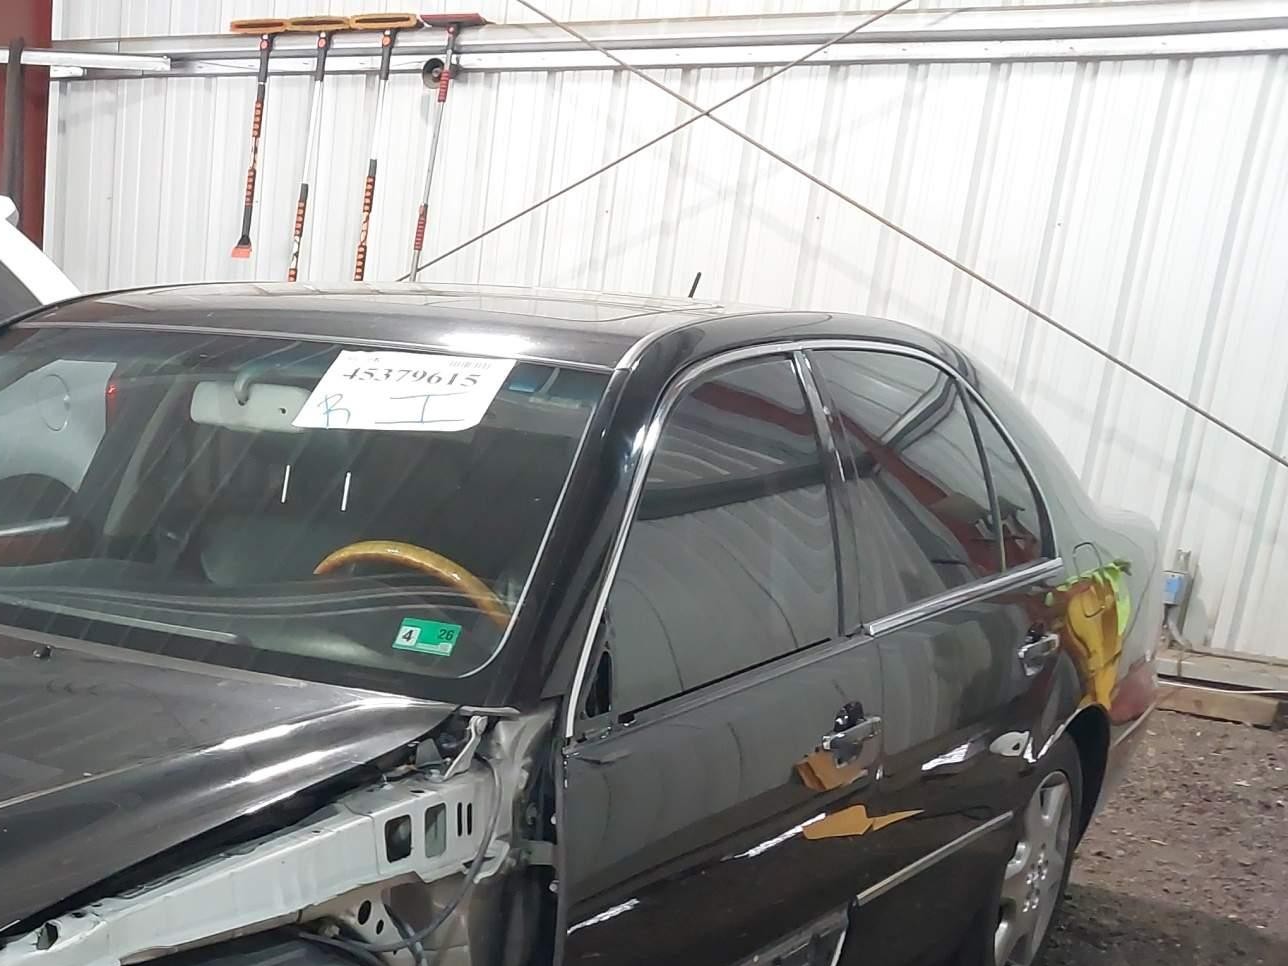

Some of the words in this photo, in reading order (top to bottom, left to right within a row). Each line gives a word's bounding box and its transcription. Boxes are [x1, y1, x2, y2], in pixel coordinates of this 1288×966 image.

[342, 367, 482, 388] 45379615
[402, 629, 414, 642] 4
[438, 628, 455, 641] 26
